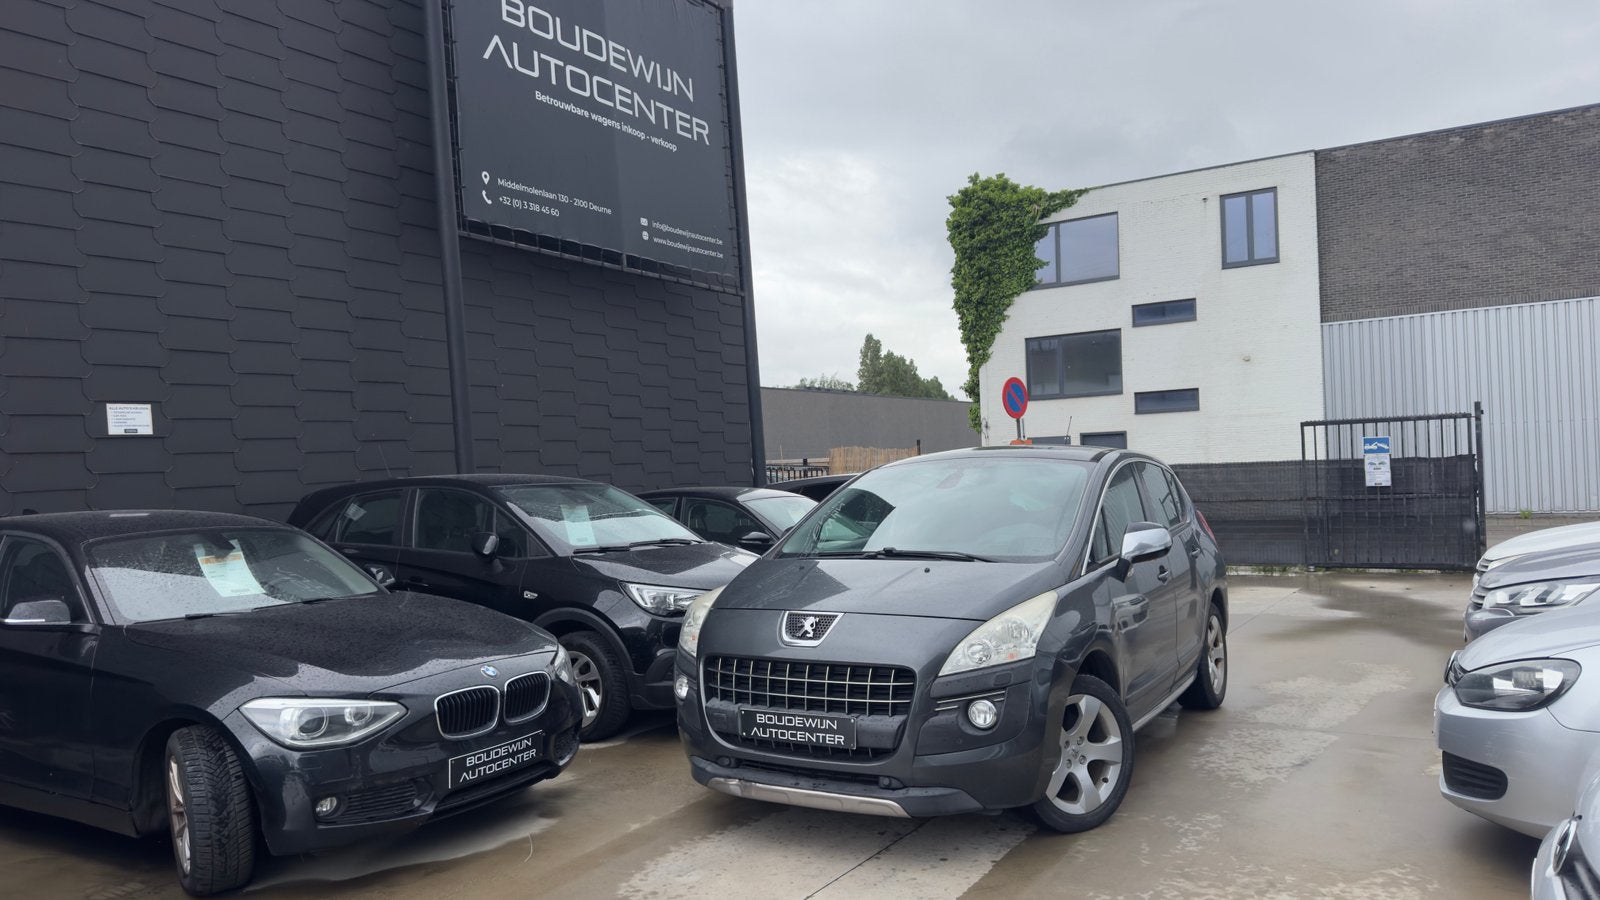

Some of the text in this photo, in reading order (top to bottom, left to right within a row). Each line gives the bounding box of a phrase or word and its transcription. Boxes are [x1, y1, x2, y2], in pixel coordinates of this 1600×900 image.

[501, 0, 693, 102] BOUDEWIJN
[483, 34, 710, 146] AUTOCENTER
[535, 90, 589, 118] Betrouwbare
[590, 112, 621, 130] wagens
[621, 122, 646, 141] inkoop
[650, 134, 678, 152] verkoop
[497, 178, 557, 201] Middelmolenlaan
[558, 193, 569, 203] 130
[573, 198, 589, 208] 2100
[589, 202, 612, 215] Deurne
[499, 196, 560, 217] +32 (0) 3 318 45 60
[652, 220, 723, 246] info@boudewijnautocenter.be
[653, 237, 724, 259] www.boudewijnautocenter.be
[751, 727, 845, 746] AUTOCENTER
[756, 713, 837, 730] BOUDEWIJN
[460, 748, 537, 783] AUTOCENTER
[466, 737, 532, 767] BOUDEWIJN
